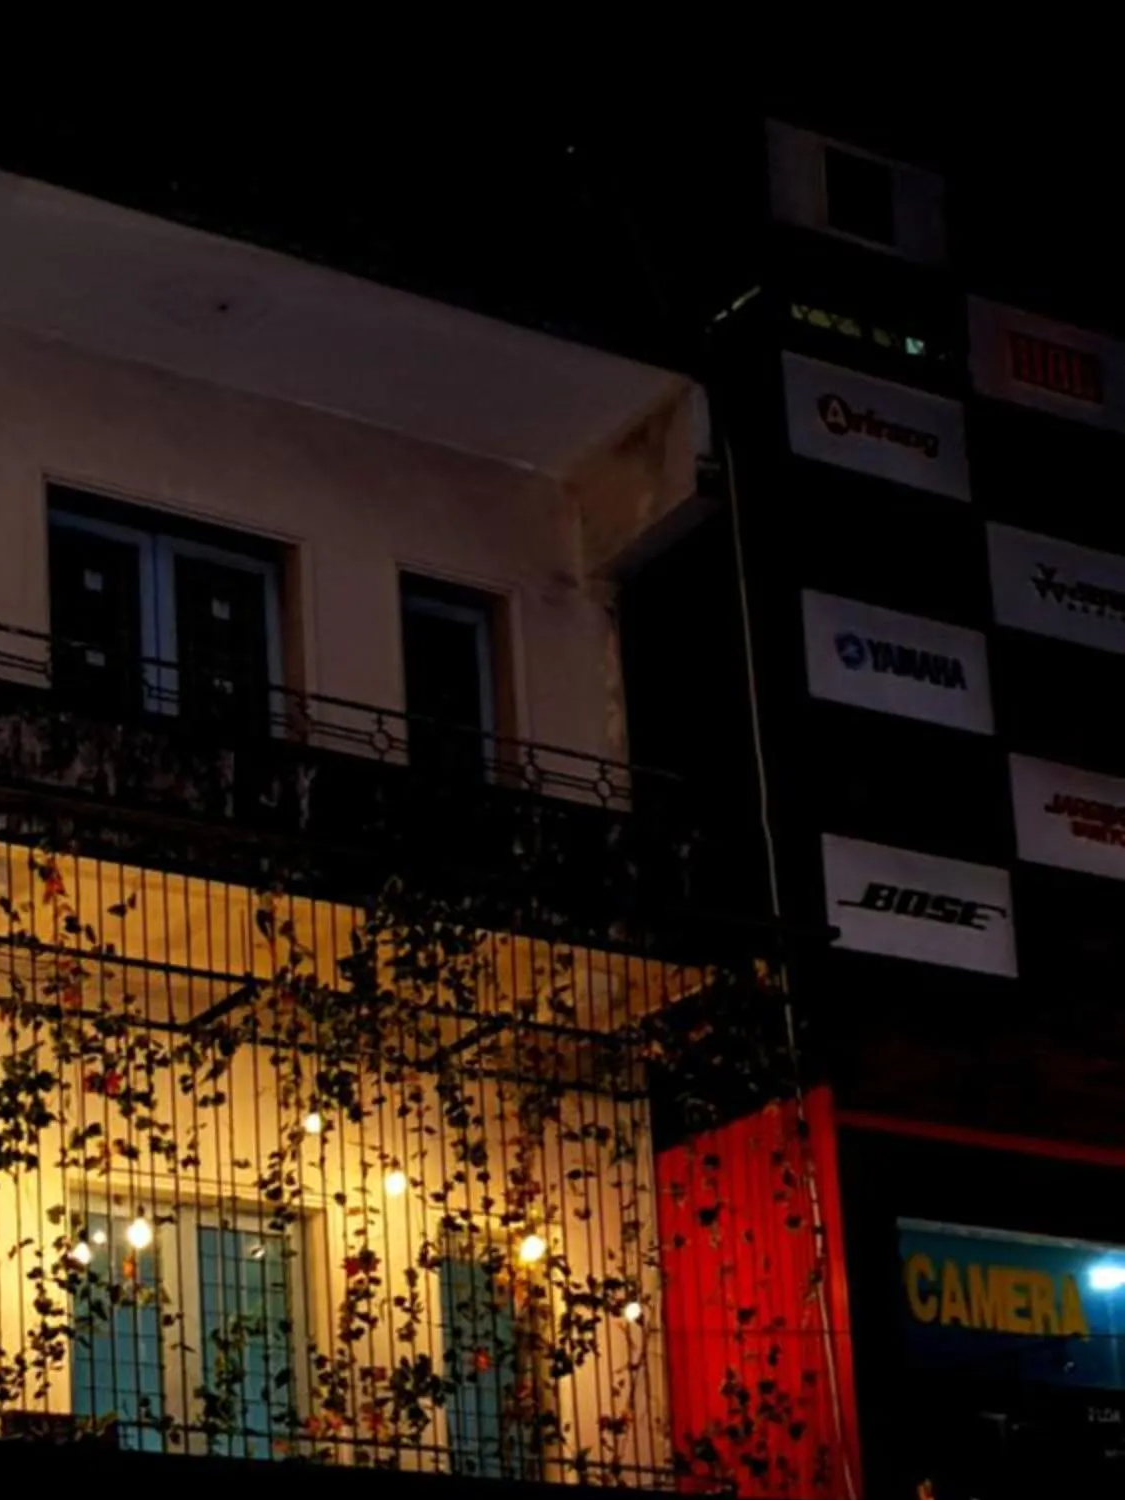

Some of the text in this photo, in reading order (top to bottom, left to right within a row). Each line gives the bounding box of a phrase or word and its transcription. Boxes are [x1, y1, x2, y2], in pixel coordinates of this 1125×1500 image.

[867, 638, 968, 690] YAMAHA
[843, 882, 1006, 931] BOSE
[903, 1252, 1091, 1343] CAMERA
